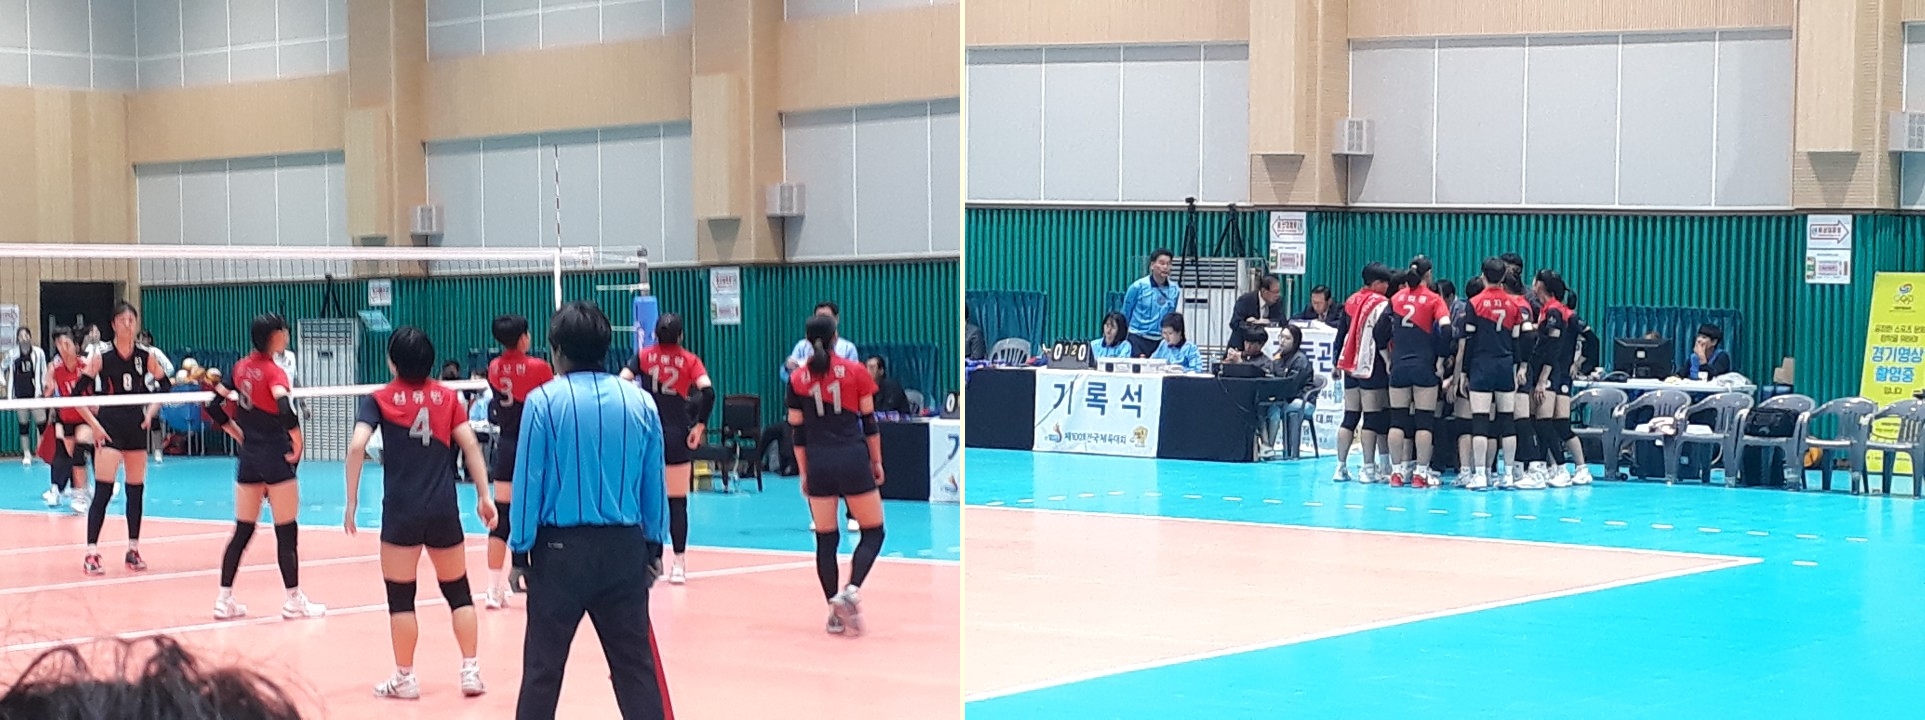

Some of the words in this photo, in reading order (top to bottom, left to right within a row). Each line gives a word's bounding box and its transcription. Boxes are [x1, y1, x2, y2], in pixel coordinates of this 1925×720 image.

[1401, 304, 1416, 329] 2
[1491, 309, 1506, 332] 7
[1872, 346, 1924, 363] 경기영상
[499, 377, 514, 408] 3
[647, 364, 679, 395] 12
[808, 380, 842, 416] 11
[1053, 381, 1143, 419] 기록석
[408, 406, 433, 447] 4
